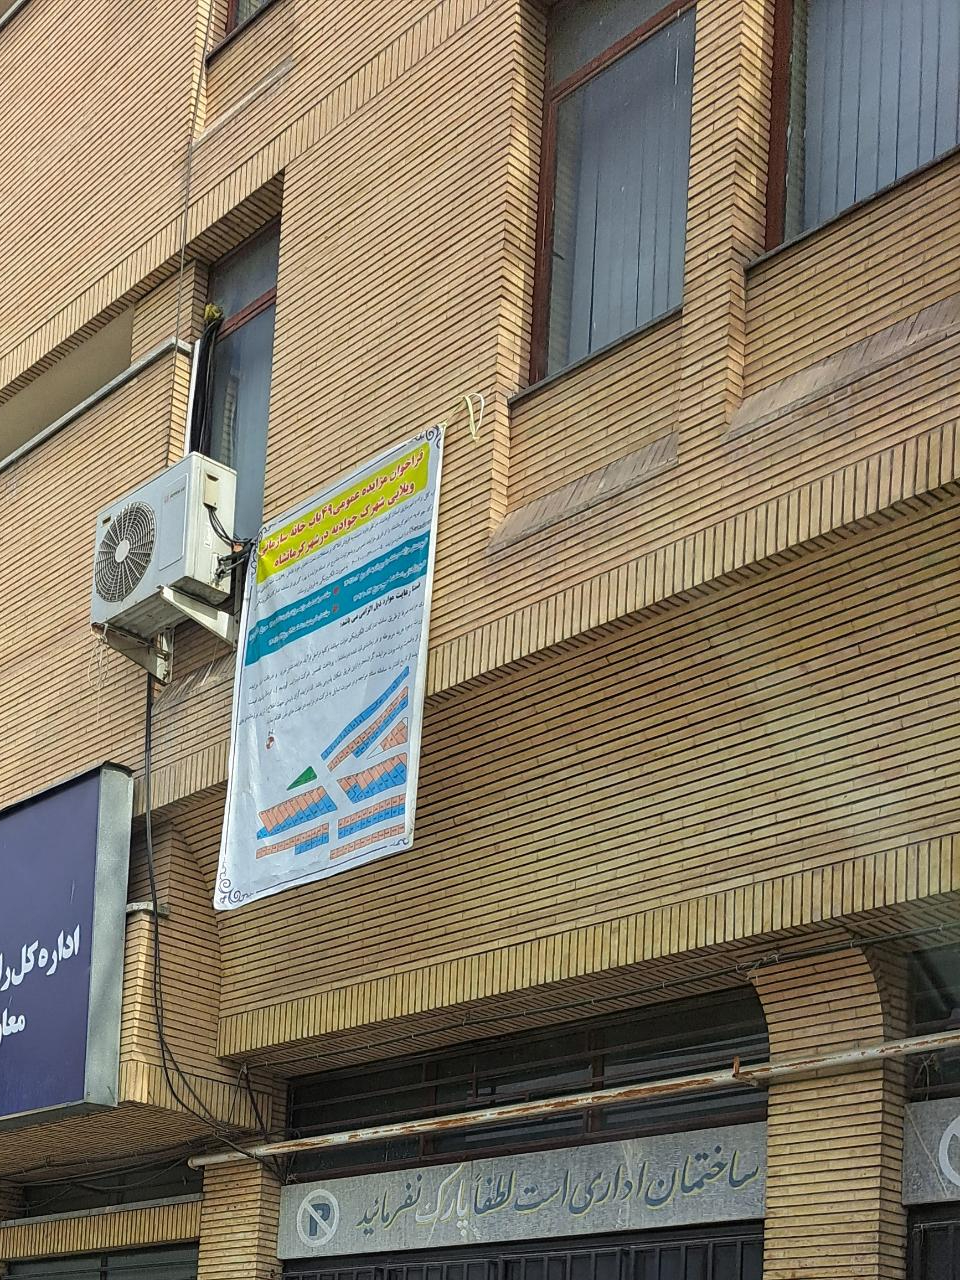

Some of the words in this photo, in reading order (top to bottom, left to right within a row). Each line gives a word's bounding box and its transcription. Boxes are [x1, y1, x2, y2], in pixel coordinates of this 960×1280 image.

[390, 448, 425, 482] فراخوان
[361, 474, 388, 495] مزایده
[332, 492, 360, 516] عمومی
[359, 498, 385, 519] شهرک
[289, 521, 306, 538] خانه
[331, 514, 358, 536] جوادیه
[258, 530, 288, 558] سازمانی
[273, 541, 306, 568] کرمانشاه
[11, 939, 39, 986] کل
[38, 923, 80, 976] اداره
[513, 1168, 572, 1214] است
[568, 1160, 649, 1217] اداری
[644, 1145, 761, 1210] ساختمان
[355, 1173, 423, 1236] نفرمائید
[415, 1162, 469, 1237] پارک
